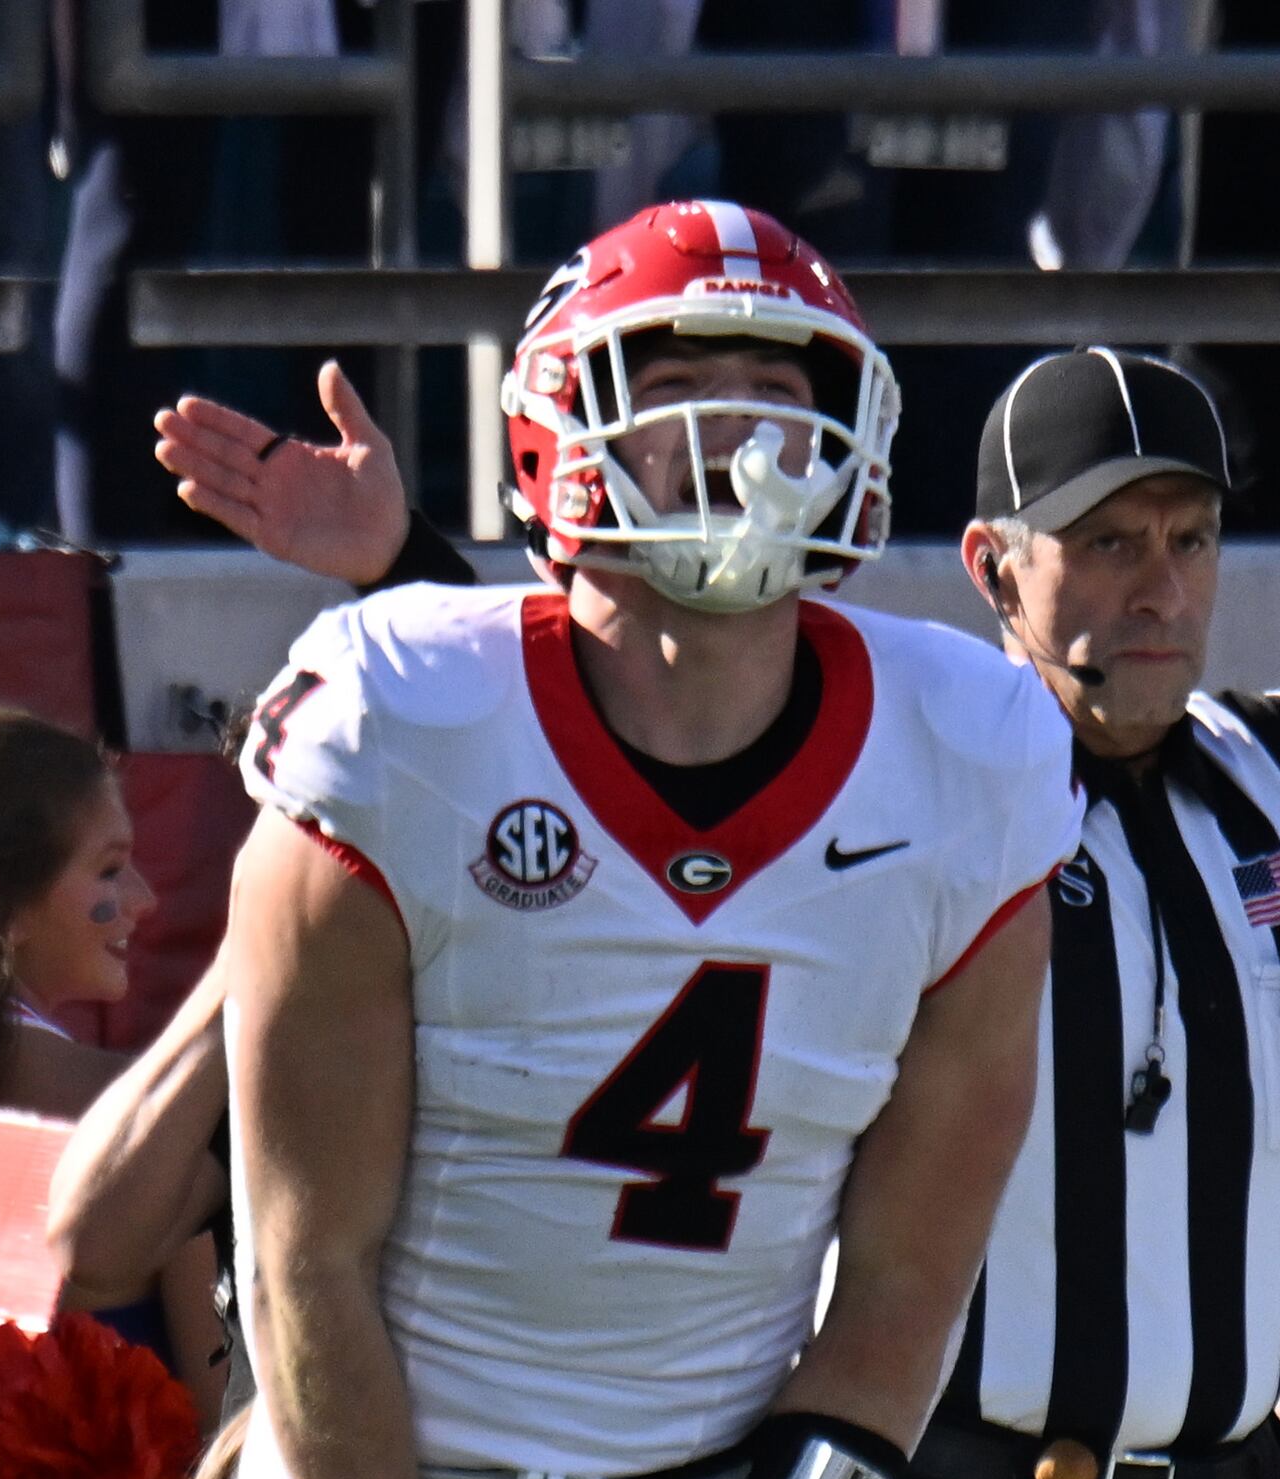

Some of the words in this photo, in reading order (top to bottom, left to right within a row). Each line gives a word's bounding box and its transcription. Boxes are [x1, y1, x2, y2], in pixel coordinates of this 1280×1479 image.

[252, 669, 328, 785] 4
[485, 875, 582, 909] GRADUATE
[495, 805, 571, 883] SEC
[560, 960, 771, 1254] 4
